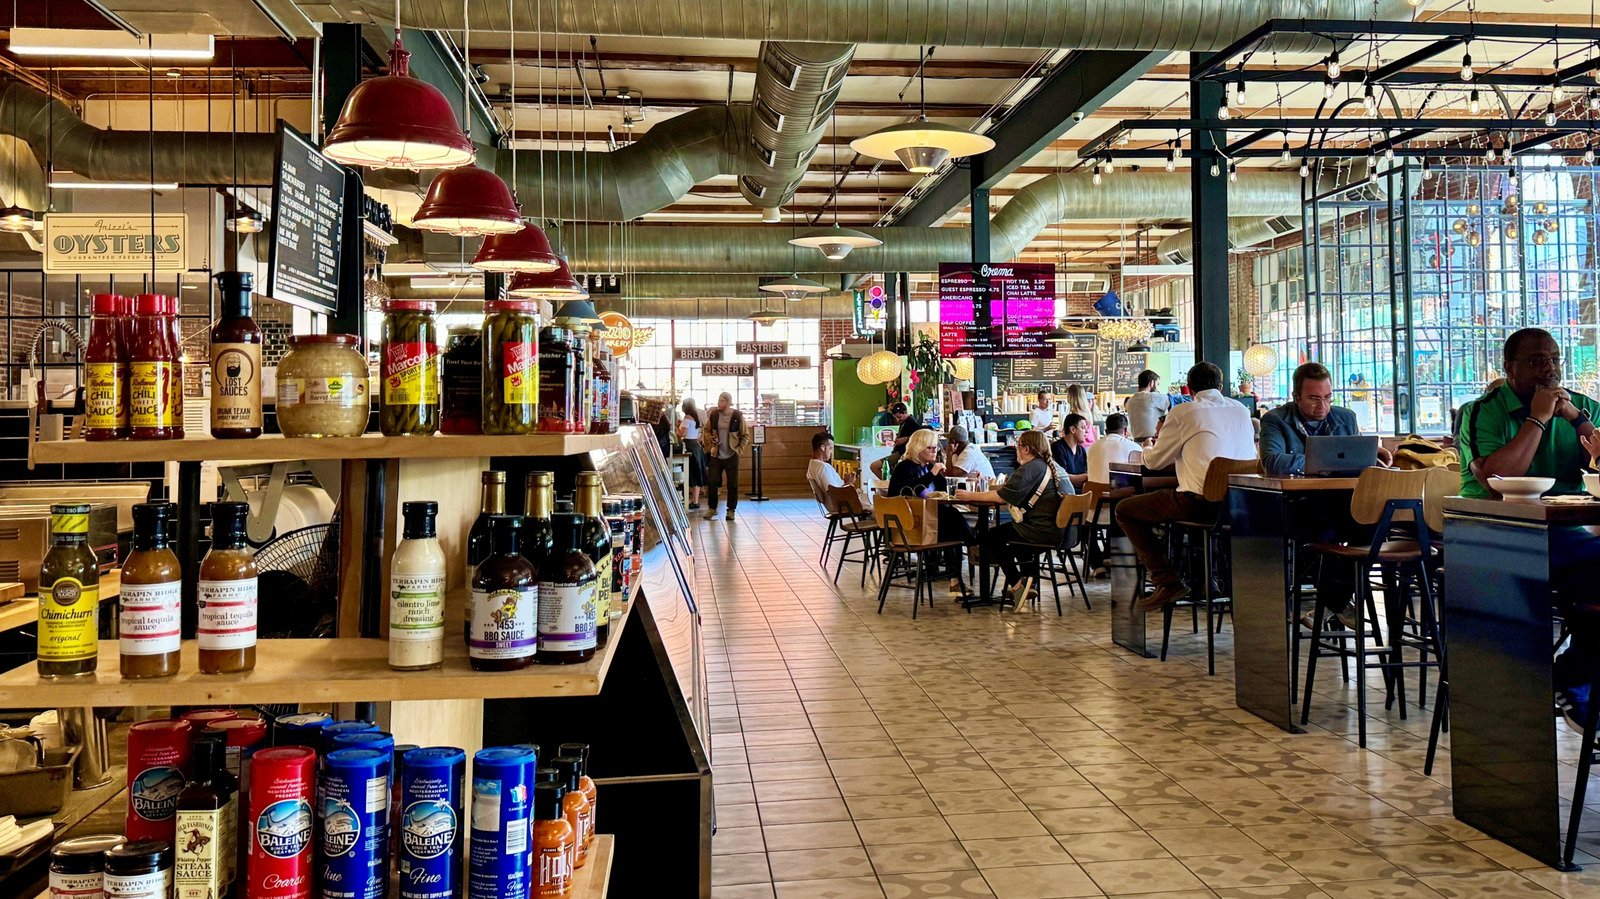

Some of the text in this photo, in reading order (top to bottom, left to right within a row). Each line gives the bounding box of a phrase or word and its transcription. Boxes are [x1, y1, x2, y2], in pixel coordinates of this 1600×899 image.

[54, 234, 181, 255] OYSTERS
[980, 264, 1014, 278] Crema
[741, 343, 783, 353] PASTRIES
[681, 349, 716, 359] BREADS
[771, 358, 800, 368] CAKES
[400, 367, 419, 379] SPORT
[705, 365, 750, 375] DESSERTS
[225, 378, 242, 387] LOST
[132, 390, 156, 402] CHILI
[219, 386, 249, 396] SAUCES
[88, 405, 118, 416] SAUCE
[130, 405, 159, 415] SAUCE
[397, 600, 425, 608] cilantro
[41, 606, 94, 620] Chimichurri
[202, 609, 254, 621] tropical tequila
[147, 614, 175, 625] tequila
[216, 618, 240, 626] sauce
[496, 620, 515, 631] 1453
[575, 623, 588, 632] BBQ
[50, 633, 82, 643] original
[484, 630, 525, 641] BBQ SAUCE
[134, 796, 175, 811] BALEIN
[178, 823, 188, 832] OLD
[260, 829, 311, 847] BALEINE
[404, 831, 453, 847] BALEINE
[176, 870, 212, 878] SAUCE
[409, 867, 442, 885] Fine
[107, 880, 143, 888] TERRAPIN
[263, 873, 306, 891] Coarse
